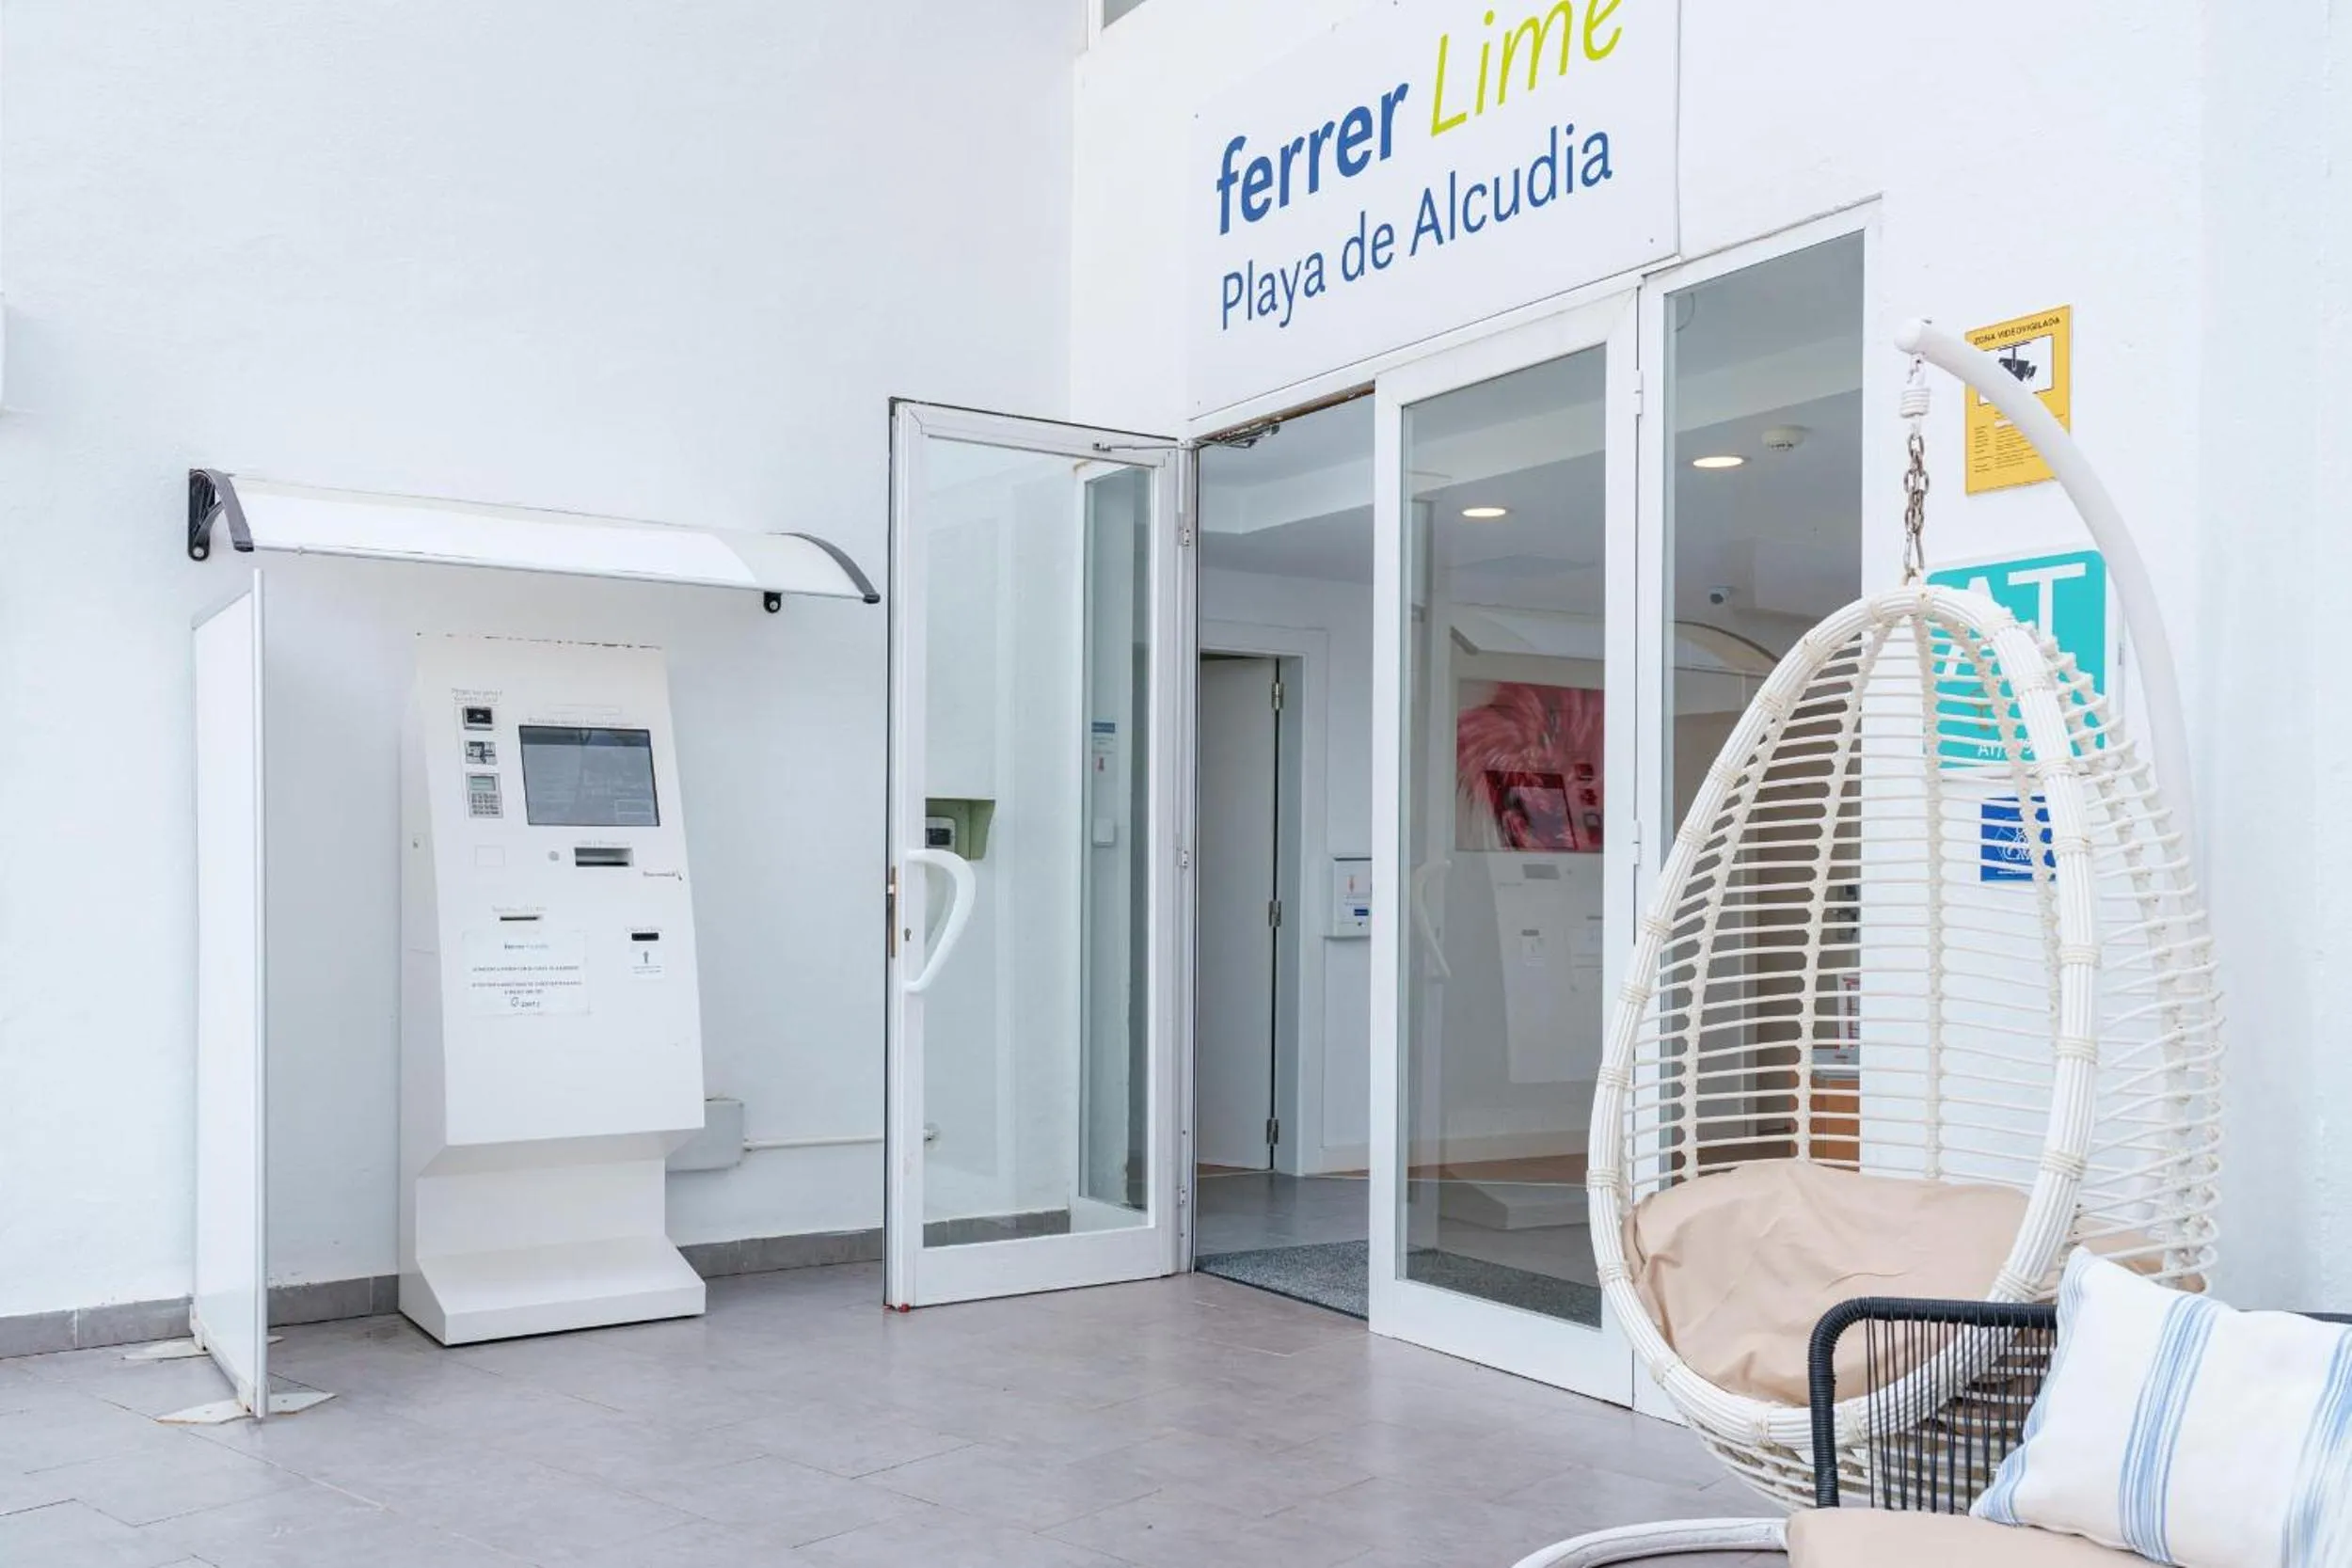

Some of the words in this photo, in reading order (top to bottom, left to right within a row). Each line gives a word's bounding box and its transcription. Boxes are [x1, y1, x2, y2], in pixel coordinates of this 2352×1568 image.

[1216, 83, 1409, 234] ferrer
[1430, 0, 1623, 136] Lime
[1222, 252, 1326, 330] Playa
[1342, 211, 1394, 282] de
[1410, 123, 1613, 256] Alcudia
[1973, 333, 1995, 345] ZONA
[1997, 316, 2060, 340] VIDEOVIGILADA
